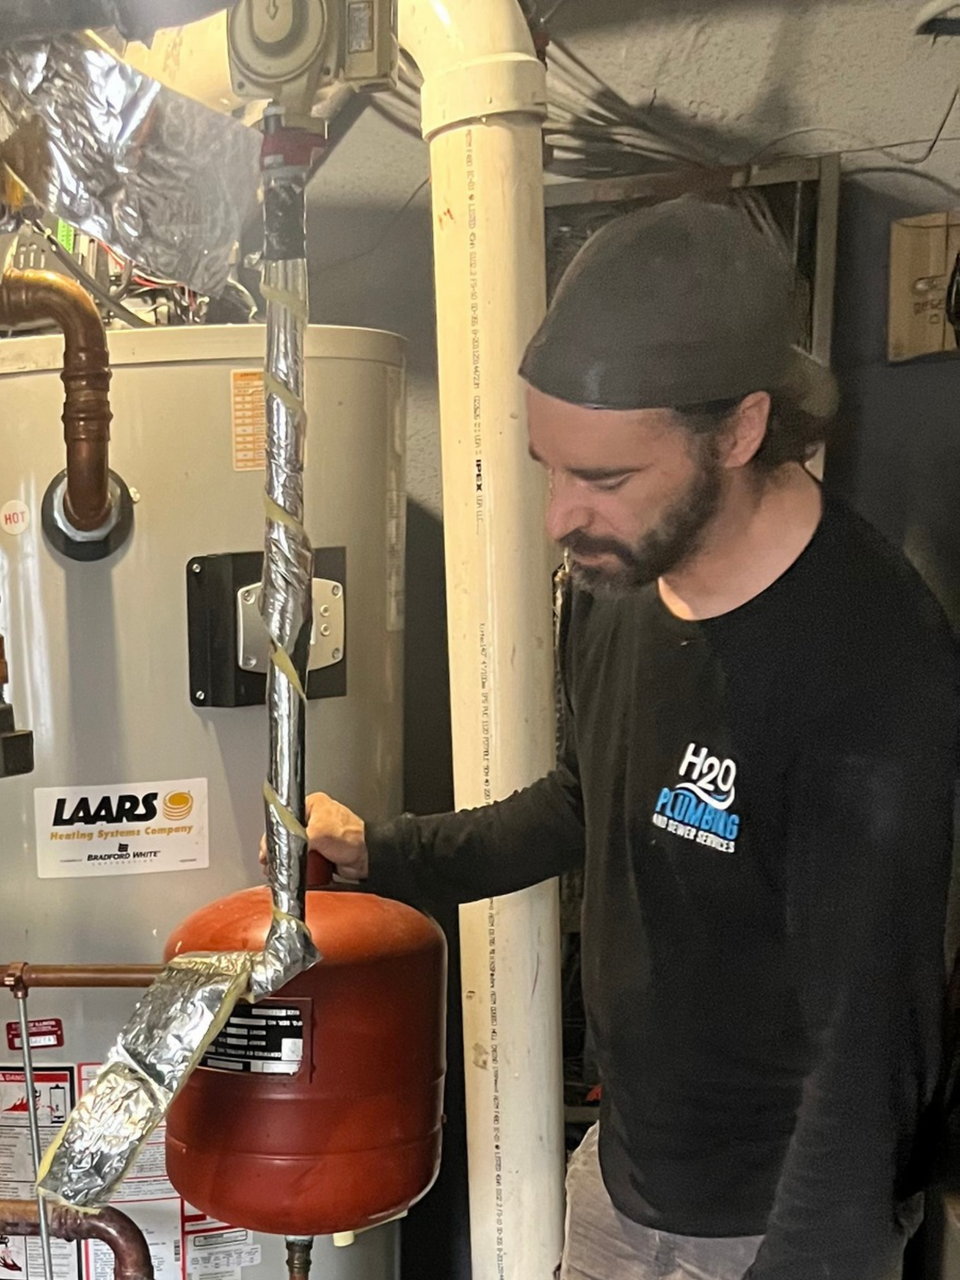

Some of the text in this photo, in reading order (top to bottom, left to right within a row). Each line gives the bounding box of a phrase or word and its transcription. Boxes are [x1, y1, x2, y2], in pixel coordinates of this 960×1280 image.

[475, 459, 483, 492] IPEX
[4, 511, 26, 525] HOT
[52, 792, 159, 827] LAARS
[50, 825, 194, 841] Heating Systems Company
[87, 852, 130, 862] BRADFORD
